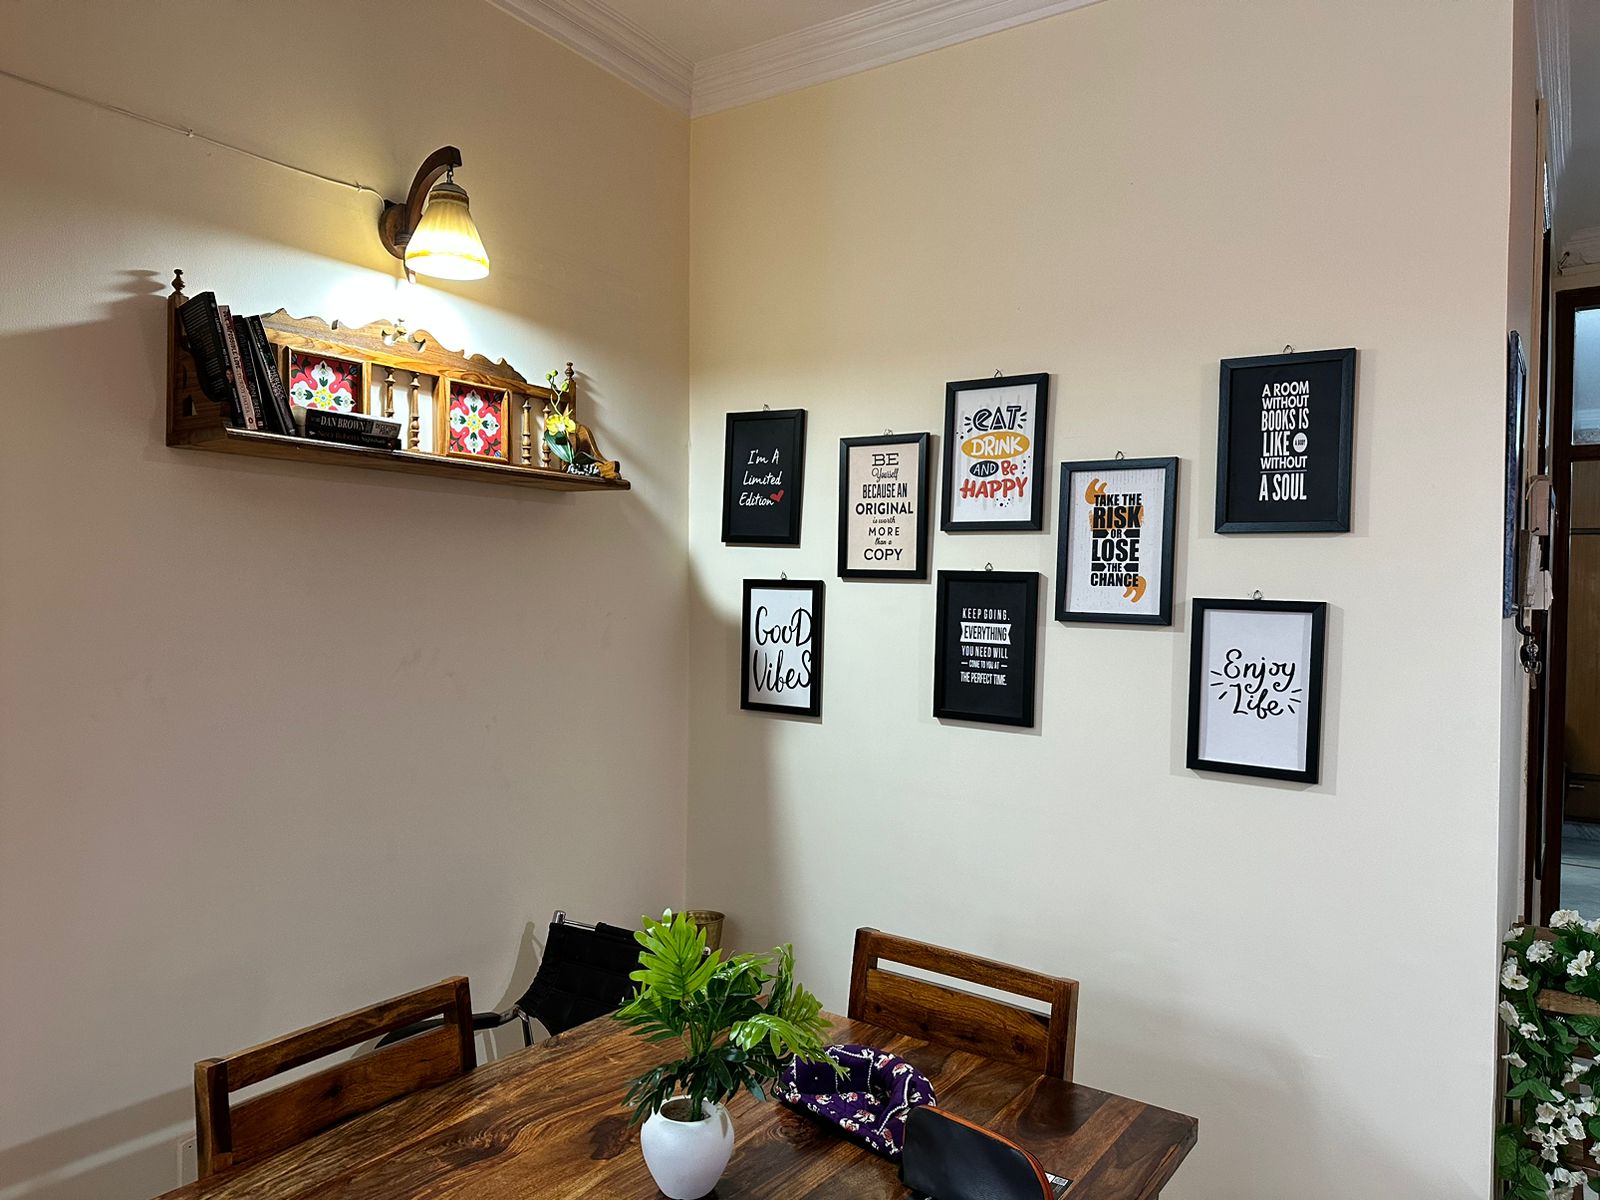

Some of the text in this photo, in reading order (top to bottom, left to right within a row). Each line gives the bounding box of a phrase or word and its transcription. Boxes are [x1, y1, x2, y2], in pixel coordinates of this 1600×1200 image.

[269, 364, 285, 400] SHERLOCK
[1262, 380, 1310, 398] A ROOM
[1262, 395, 1310, 410] WITHOUT
[320, 416, 336, 426] DAN
[338, 418, 366, 431] BROWN
[1261, 408, 1309, 431] BOOKS IS
[971, 436, 1024, 457] DRINK
[1262, 430, 1290, 456] LIKE
[747, 448, 780, 465] I'm A
[872, 452, 899, 466] BE
[1260, 456, 1308, 470] WITHOUT
[872, 468, 899, 482] Yourself
[972, 462, 996, 476] AND
[742, 470, 782, 486] Limited
[862, 482, 908, 499] BECAUSE AN
[960, 476, 1028, 499] HAPPY
[1258, 473, 1307, 501] A SOUL
[738, 492, 774, 508] Edition
[1094, 493, 1142, 506] TAKE THE
[856, 502, 914, 515] ORIGINAL
[872, 516, 896, 524] is worth
[1093, 506, 1141, 528] RISK
[868, 526, 900, 536] MORE
[1110, 529, 1122, 539] OR
[875, 538, 887, 546] than
[864, 548, 903, 561] COPY
[1092, 539, 1140, 562] LOSE
[1106, 563, 1122, 573] THE
[1090, 573, 1139, 587] CHANCE
[962, 608, 1010, 621] KEEP GOING.
[964, 625, 1008, 642] EVERYTHING
[961, 645, 1008, 659] YOU NEED WILL
[960, 672, 970, 682] THE
[971, 672, 992, 684] PERFECT
[1224, 648, 1296, 694] Enjoy
[1229, 683, 1284, 720] Life
